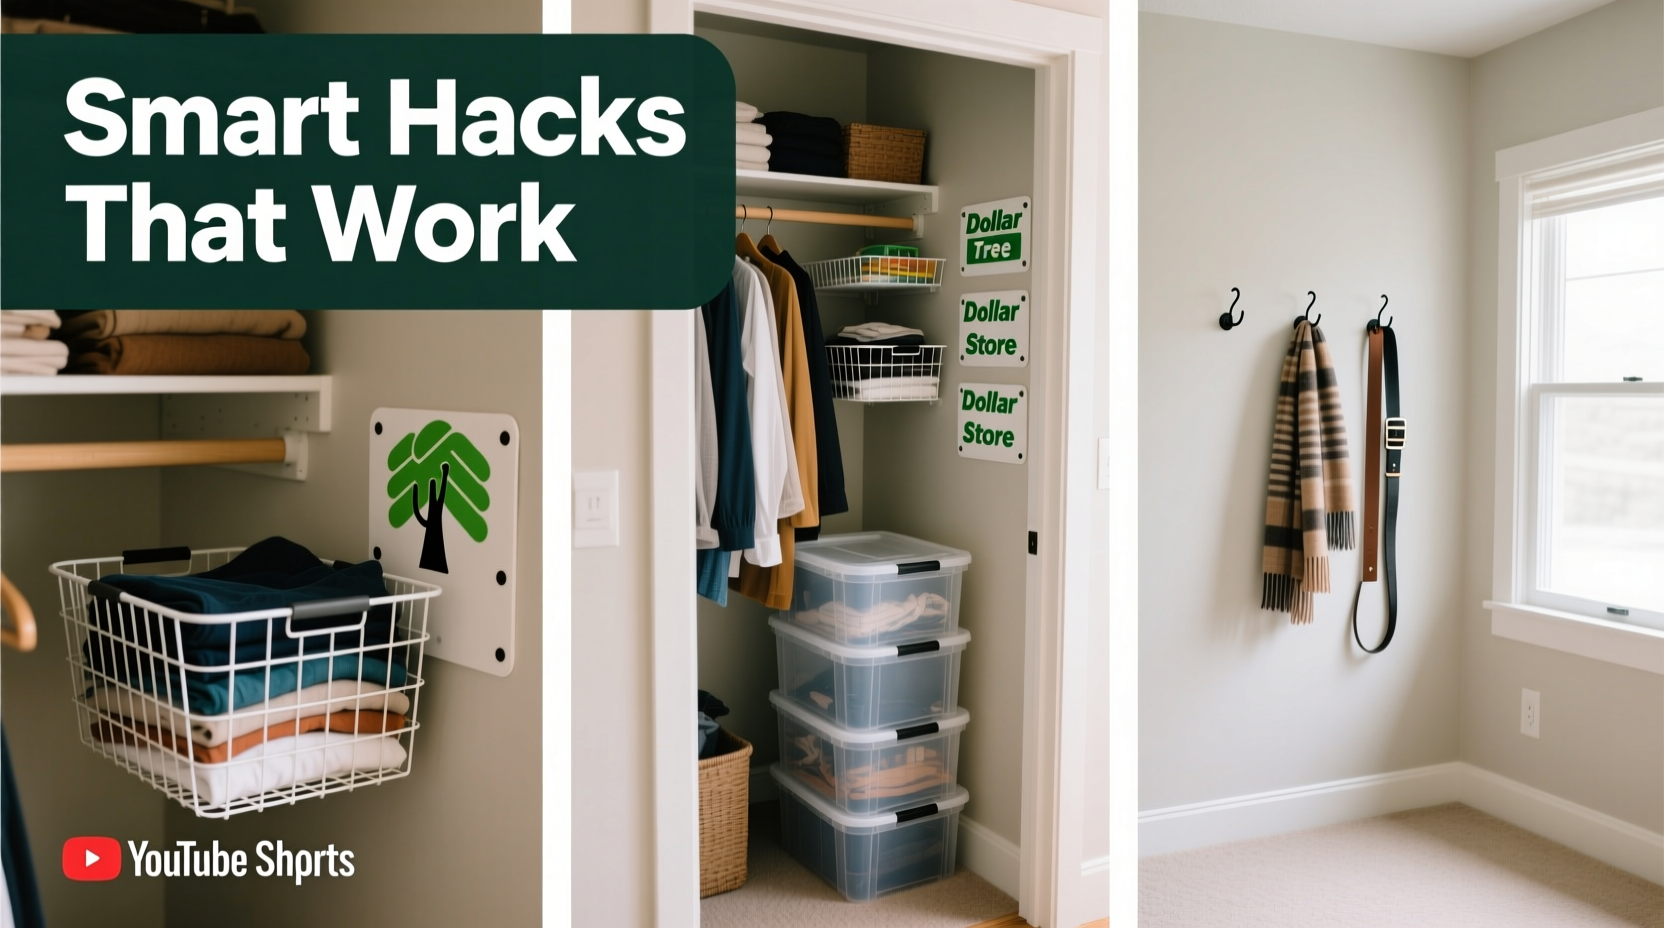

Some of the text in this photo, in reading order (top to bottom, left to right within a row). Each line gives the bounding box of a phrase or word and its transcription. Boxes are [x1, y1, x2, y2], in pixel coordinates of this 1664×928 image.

[966, 208, 1023, 235] Dollar
[974, 240, 1012, 260] Tree
[963, 299, 1020, 322] Dollar
[965, 332, 1018, 356] Store
[961, 389, 1019, 414] Dollar
[962, 421, 1015, 448] Store
